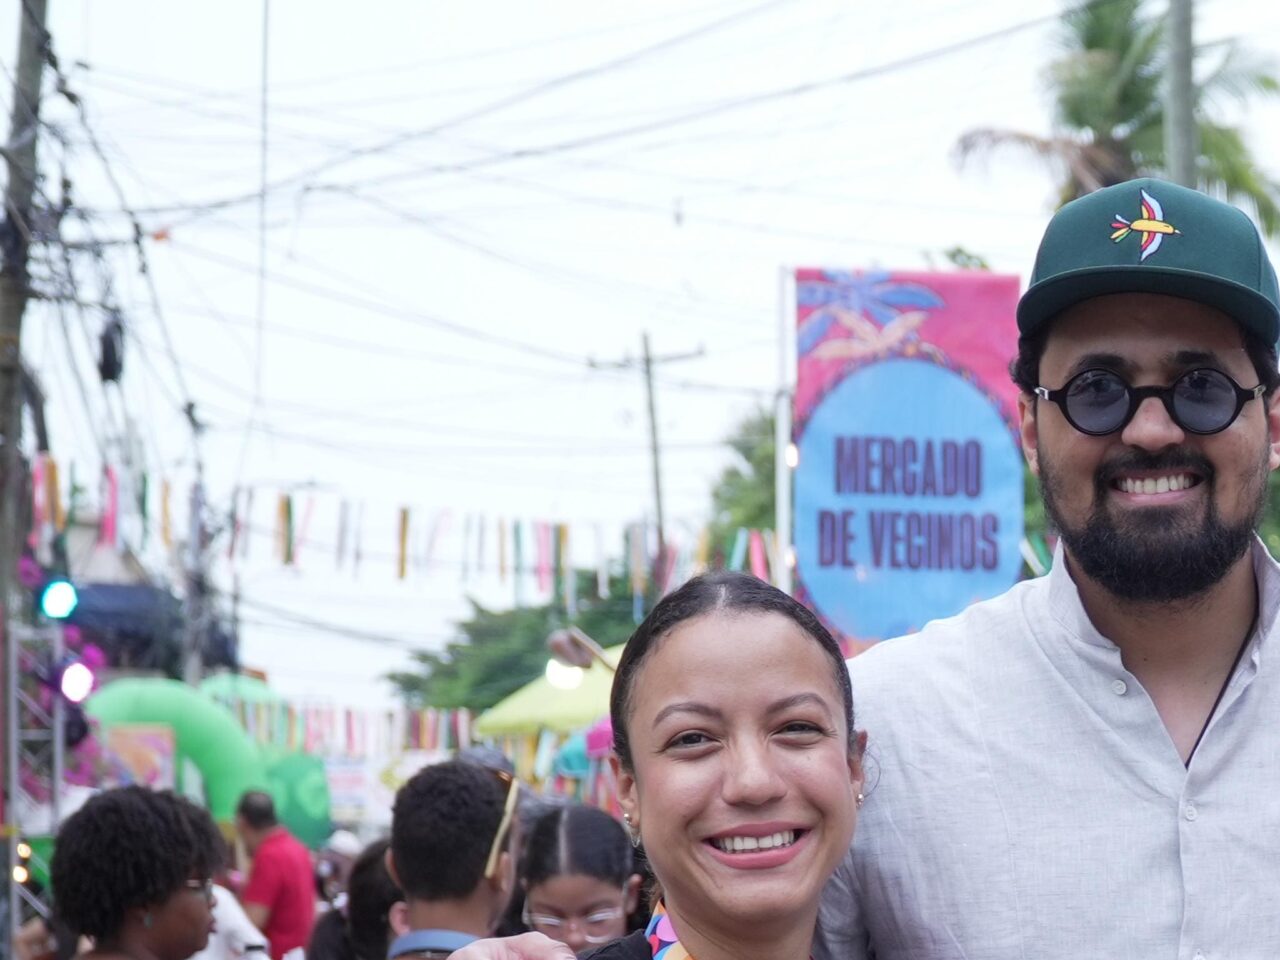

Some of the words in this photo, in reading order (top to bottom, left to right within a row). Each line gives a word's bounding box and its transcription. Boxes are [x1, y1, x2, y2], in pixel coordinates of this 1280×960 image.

[834, 435, 983, 497] MERCADO
[818, 510, 855, 567] DE
[868, 511, 998, 571] VECINOS
